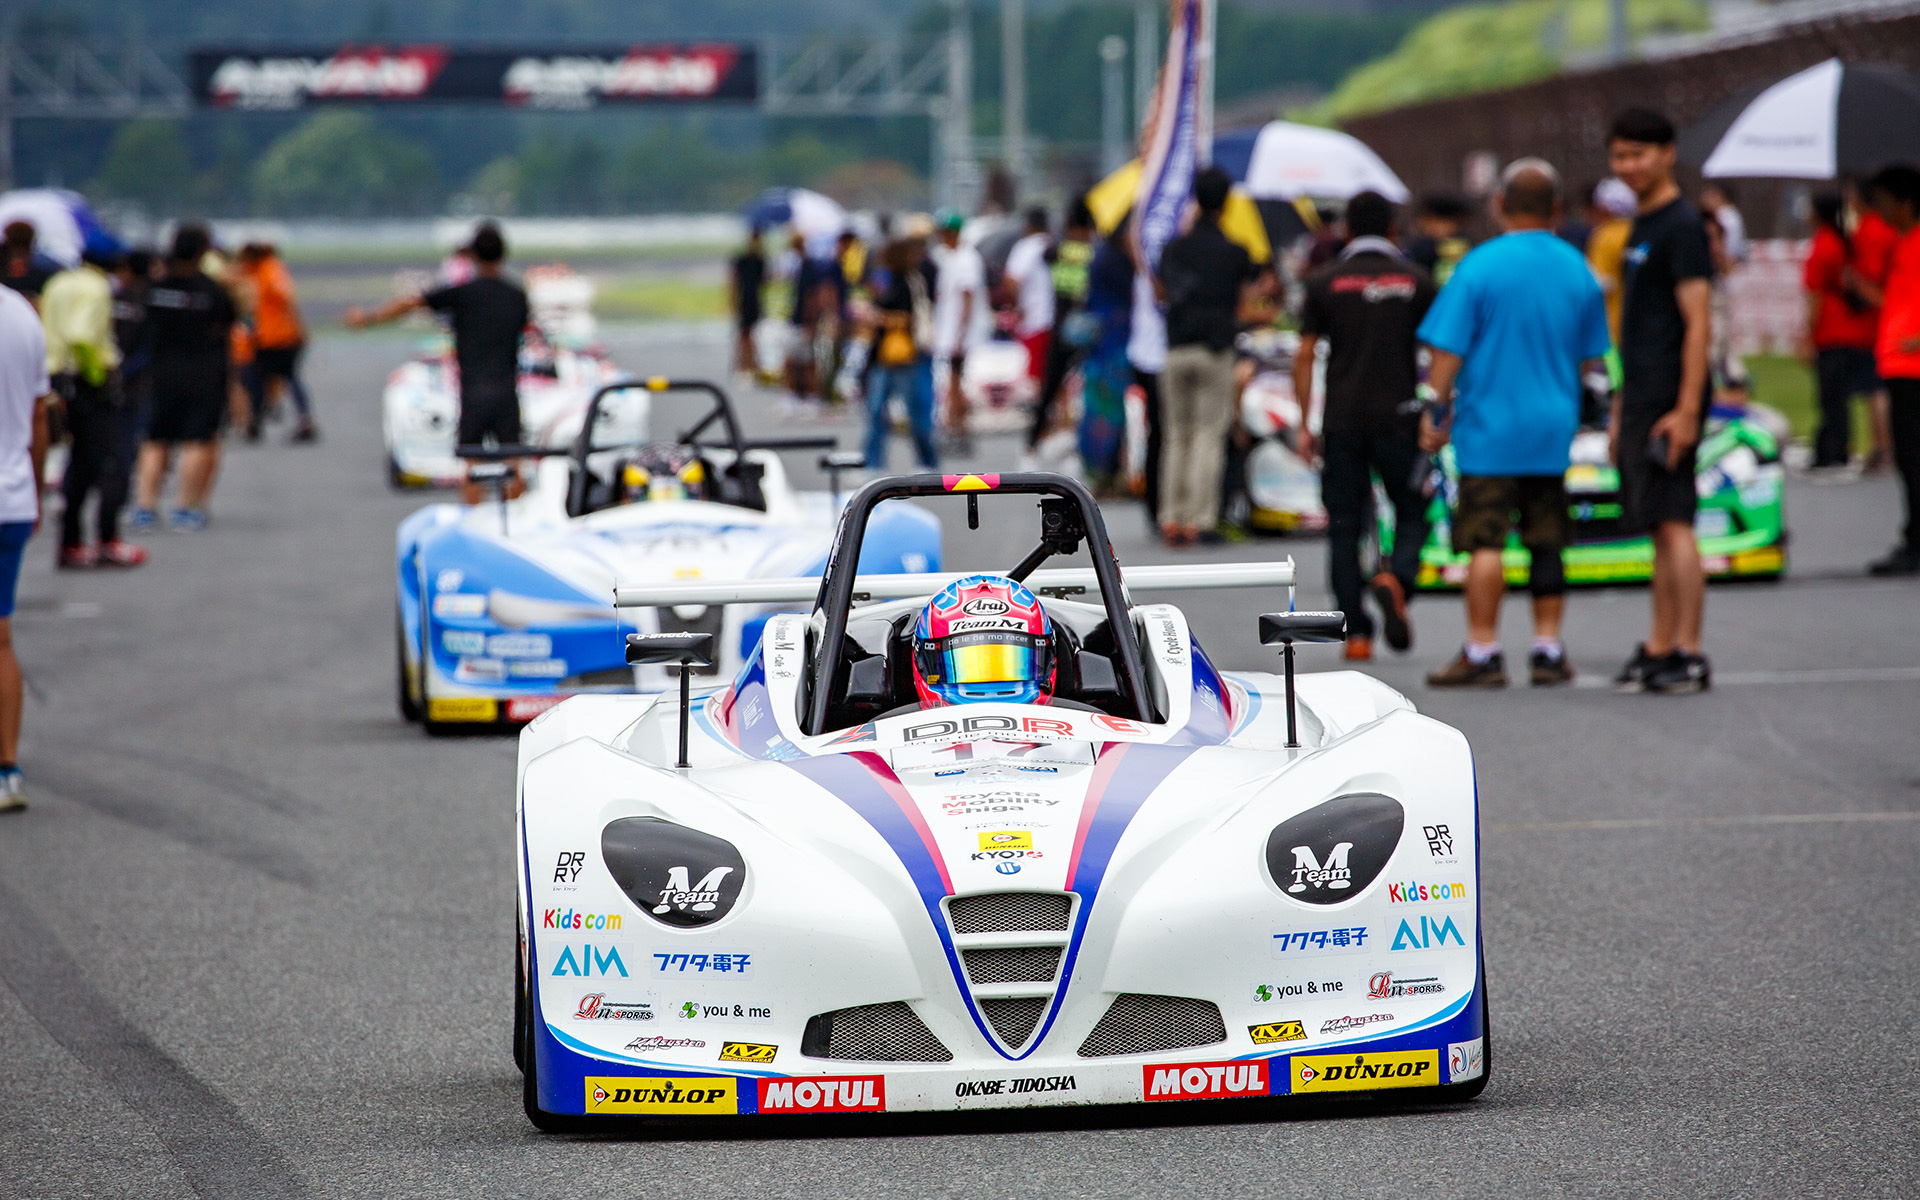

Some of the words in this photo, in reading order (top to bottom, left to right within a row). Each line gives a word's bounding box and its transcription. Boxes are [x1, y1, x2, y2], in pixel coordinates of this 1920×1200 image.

[968, 598, 1005, 612] Arai
[952, 620, 997, 631] Team
[997, 619, 1025, 630] M
[636, 630, 693, 640] G-SHOCK
[961, 635, 970, 643] le
[1006, 634, 1028, 643] racer
[775, 642, 795, 651] M
[1163, 636, 1184, 654] Cycle
[1099, 714, 1141, 734] E
[931, 738, 1052, 761] 17
[942, 797, 1060, 809] Mobility
[944, 791, 1041, 801] Toyota
[947, 806, 1024, 816] Shiga
[1423, 824, 1452, 840] DR
[1428, 839, 1454, 856] RY
[557, 852, 586, 866] DR
[553, 867, 583, 883] RY
[1291, 867, 1351, 884] Team
[659, 889, 719, 905] Team
[1273, 926, 1369, 952] フクダ電子
[1390, 915, 1466, 951] AIM
[551, 944, 629, 977] AIM
[653, 953, 751, 973] フクダ電子
[1277, 983, 1303, 999] you
[1307, 981, 1318, 994] &
[1322, 980, 1344, 993] me
[703, 1006, 728, 1019] you
[733, 1005, 744, 1017] &
[748, 1007, 771, 1018] me
[1322, 1061, 1430, 1081] DUNLOP
[955, 1079, 1006, 1097] OKABE
[1008, 1075, 1077, 1094] JIDOSHA
[1149, 1064, 1264, 1095] MOTUL
[612, 1088, 726, 1104] DUNLOP
[763, 1080, 880, 1109] MOTUL
